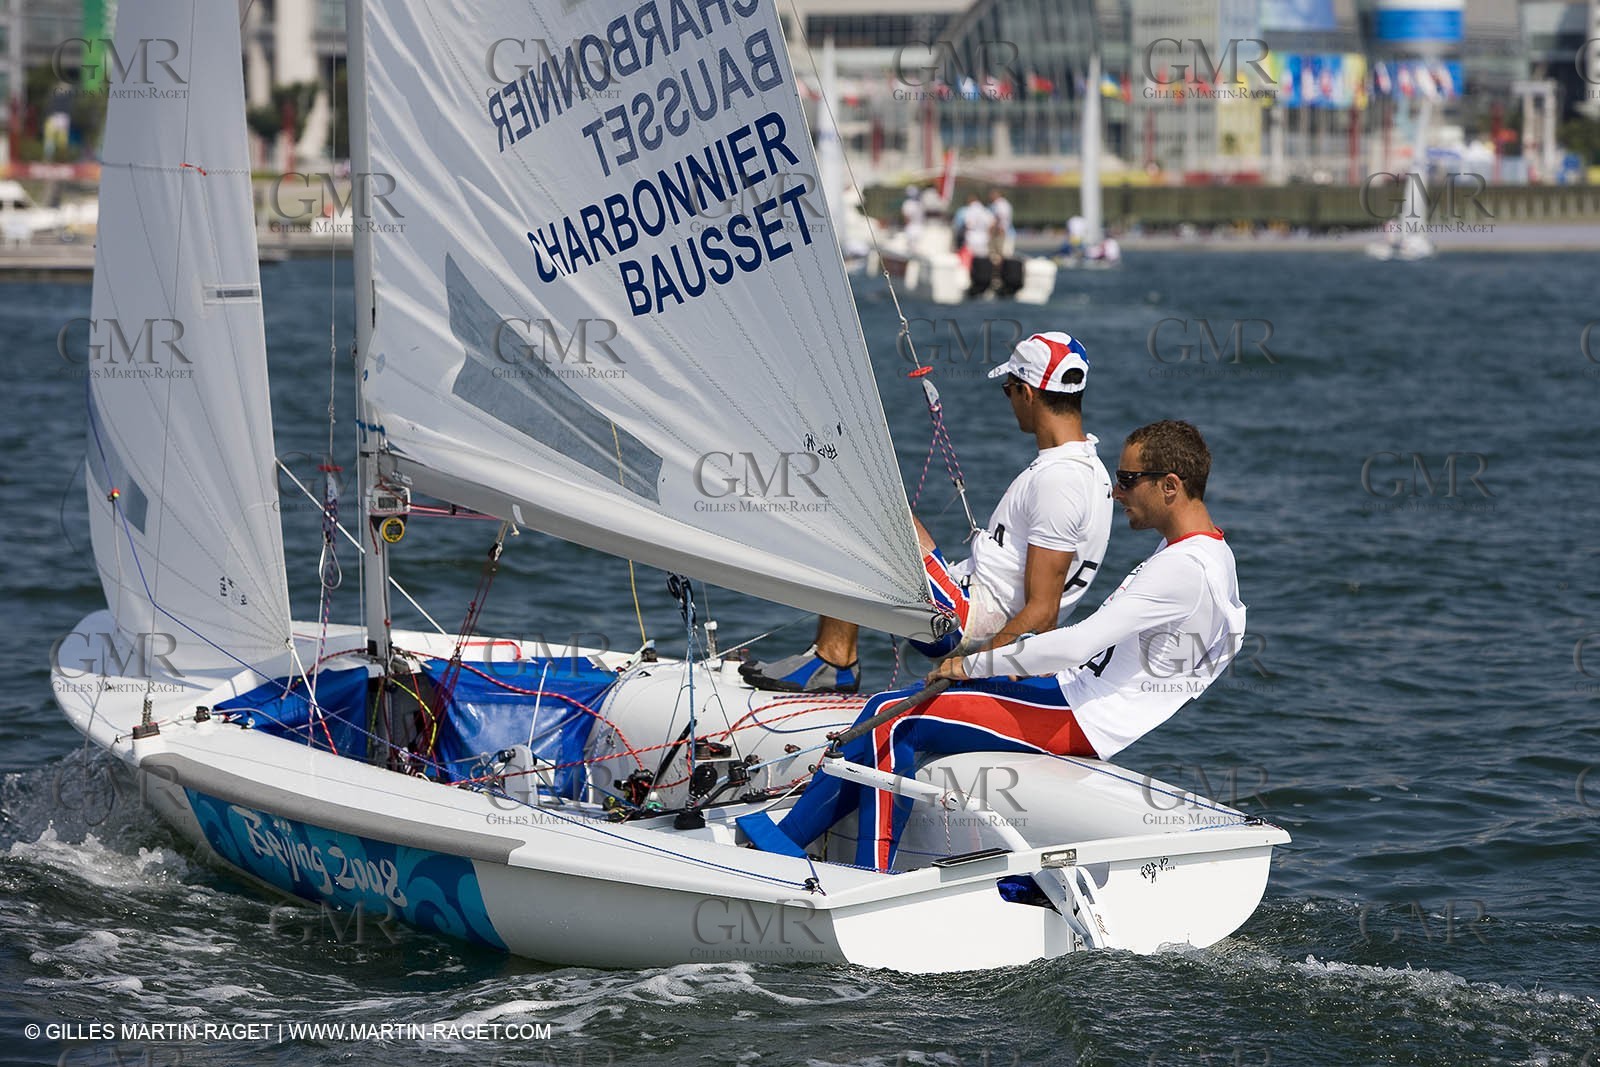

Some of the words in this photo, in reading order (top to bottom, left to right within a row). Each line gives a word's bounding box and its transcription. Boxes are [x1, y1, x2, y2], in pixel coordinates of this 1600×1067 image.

[527, 111, 800, 283] CHARBONNIER
[619, 183, 812, 316] BAUSSET
[231, 805, 333, 895] Beijing
[328, 846, 408, 907] 2008
